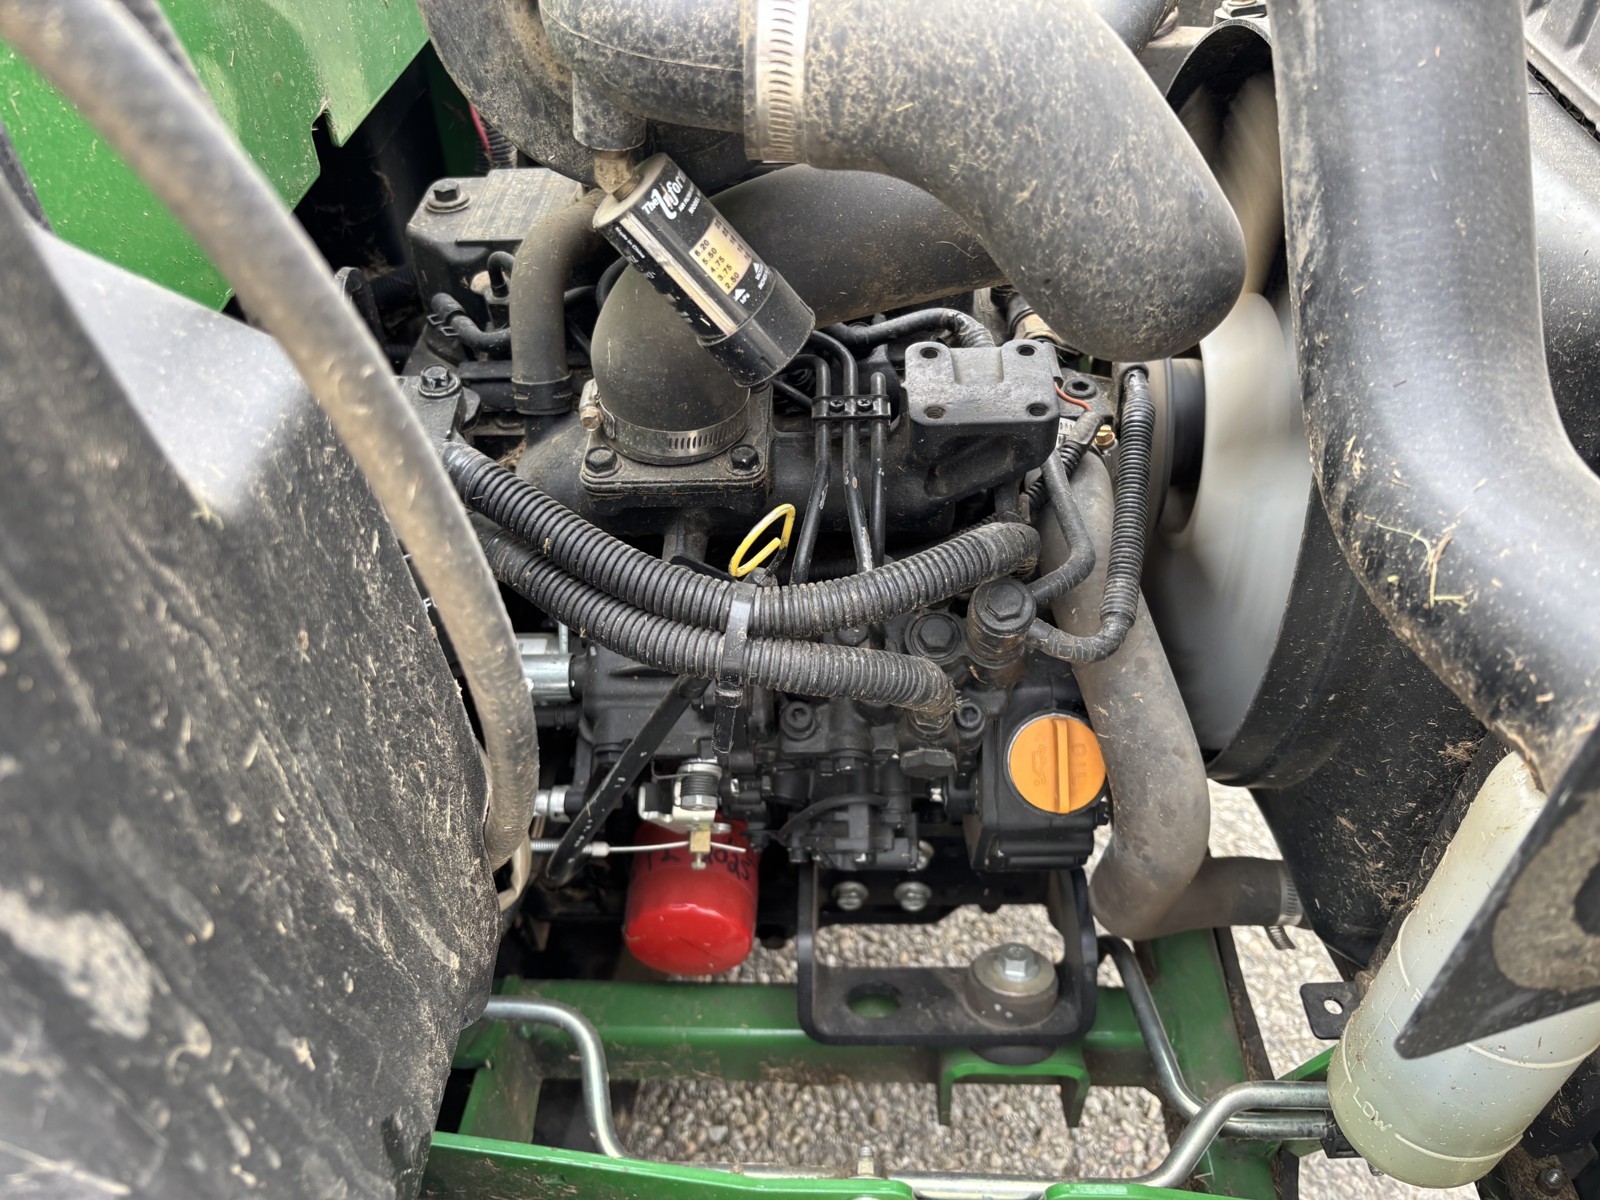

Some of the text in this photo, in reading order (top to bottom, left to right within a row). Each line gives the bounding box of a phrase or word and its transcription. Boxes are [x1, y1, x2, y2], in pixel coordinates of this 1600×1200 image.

[641, 198, 660, 215] The
[631, 243, 646, 259] China
[694, 239, 710, 257] 6.20
[702, 247, 718, 265] 5.50
[710, 256, 725, 273] 4.75
[717, 264, 733, 281] 3.75
[725, 272, 740, 289] 2.50
[1070, 743, 1088, 786] OIL
[1353, 1086, 1392, 1131] LOW
